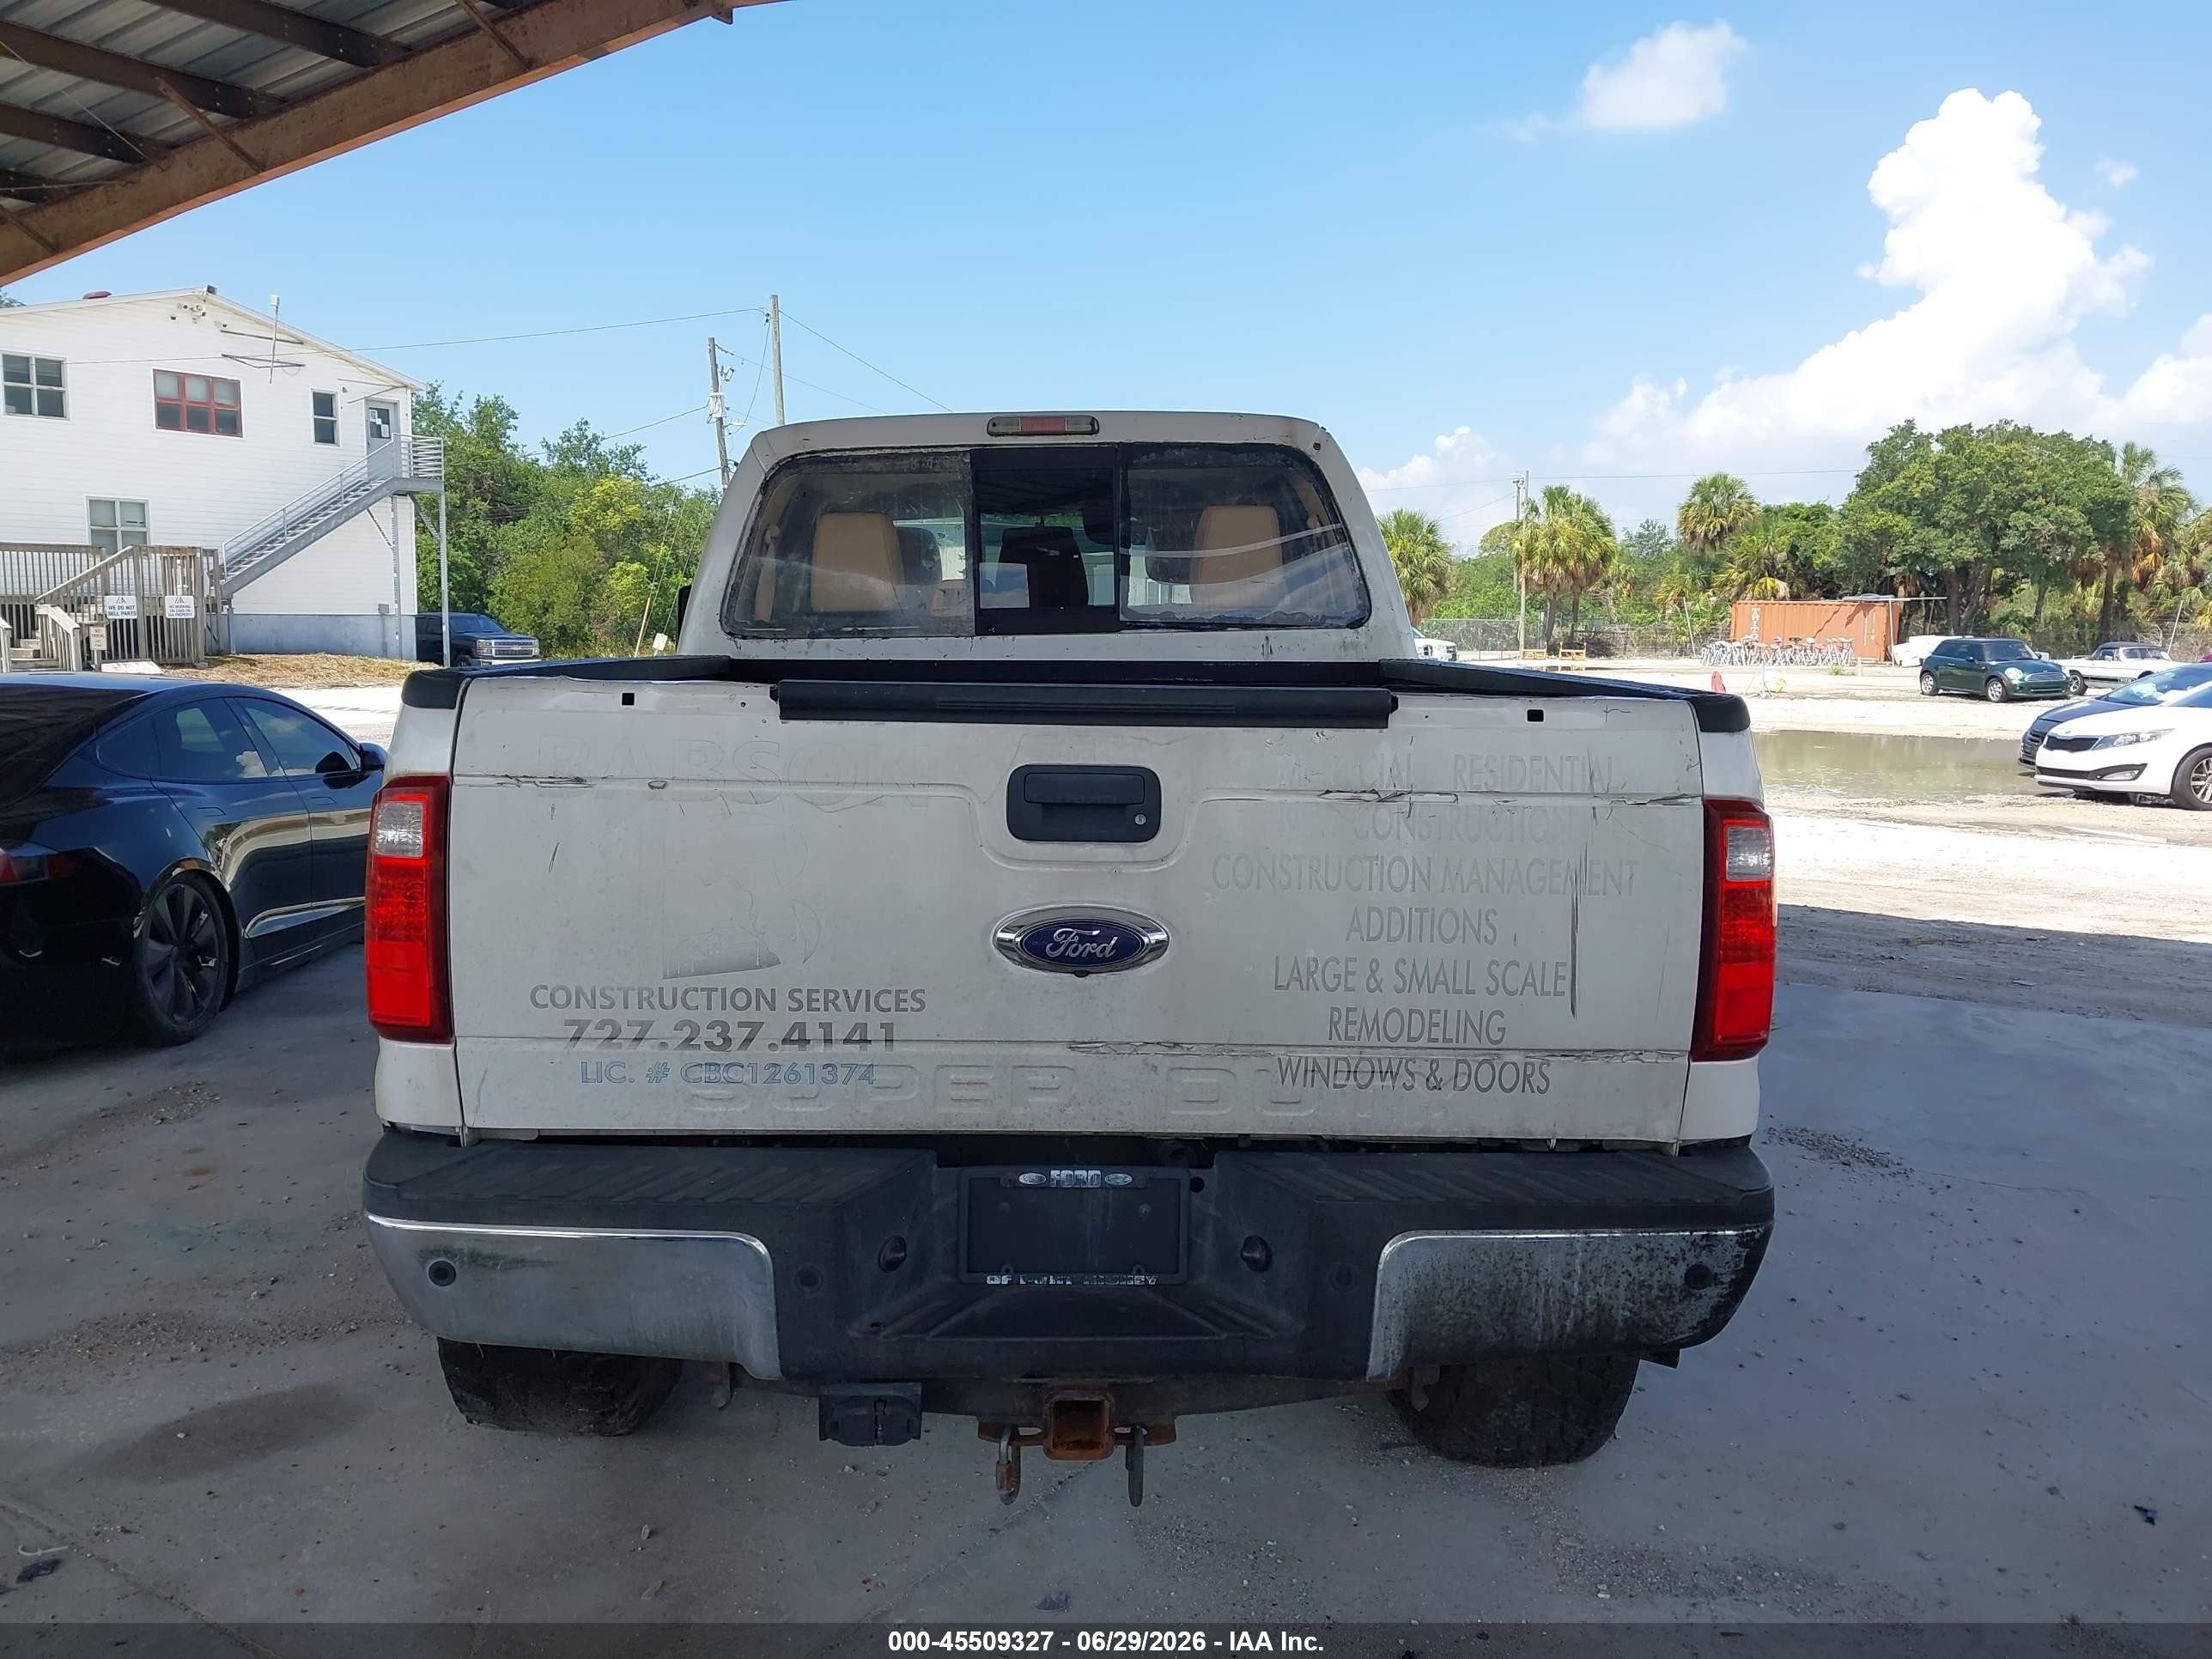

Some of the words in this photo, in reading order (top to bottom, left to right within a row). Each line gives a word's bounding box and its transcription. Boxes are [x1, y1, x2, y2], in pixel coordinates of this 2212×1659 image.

[1454, 752, 1620, 793] RESIDENTIAL
[1212, 853, 1431, 894] CONSTRUCTION
[1441, 857, 1641, 897] MANAGEMENT
[1045, 927, 1117, 958] Ford
[1345, 906, 1498, 945] ADDITIONS
[1273, 956, 1357, 993] LARGE
[1365, 958, 1384, 994] &
[1394, 958, 1476, 995] SMALL
[1486, 959, 1567, 998] SCALE
[530, 984, 777, 1012] CONSTRUCTION
[787, 988, 927, 1013] SERVICES
[562, 1018, 895, 1053] 727.237.4141
[1328, 1006, 1507, 1046] REMODELING
[579, 1061, 635, 1085] LIC.
[645, 1061, 671, 1085] #
[679, 1061, 878, 1086] CBC1261374
[687, 1064, 1076, 1115] SUPER
[1277, 1057, 1418, 1092] WINDOWS
[1425, 1058, 1444, 1092] &
[1452, 1057, 1551, 1095] DOORS
[1049, 1170, 1102, 1188] FORD
